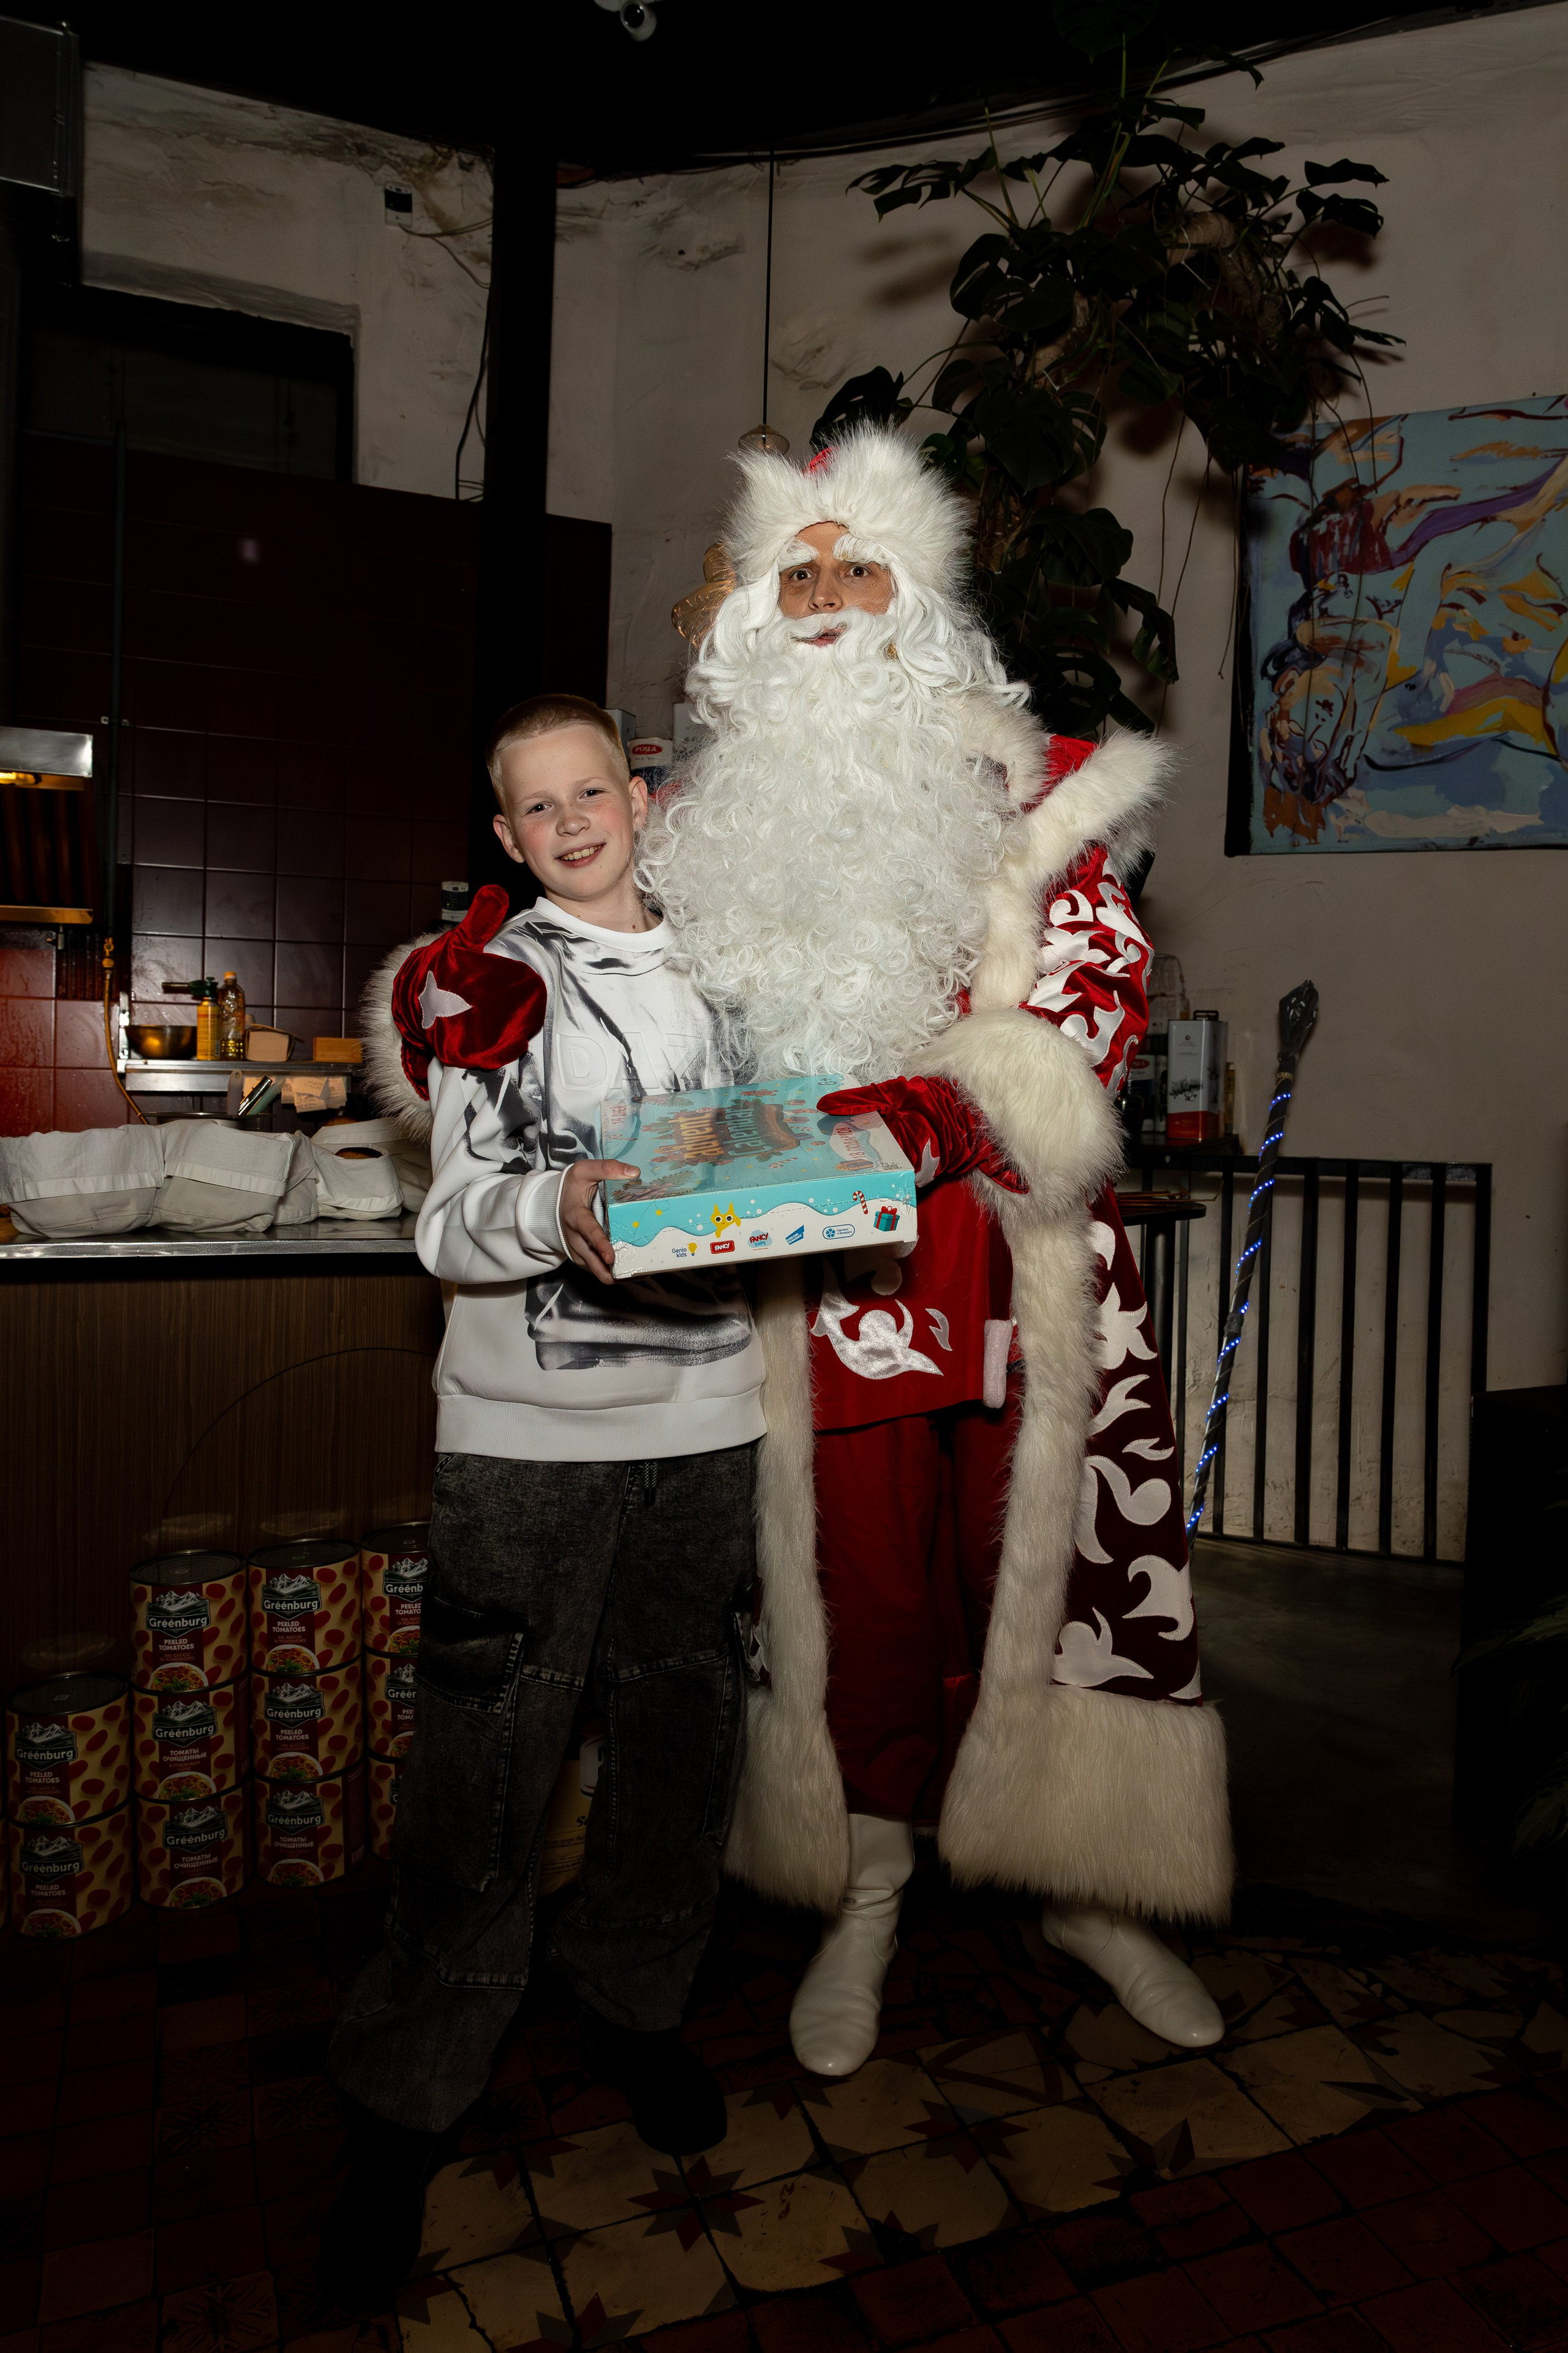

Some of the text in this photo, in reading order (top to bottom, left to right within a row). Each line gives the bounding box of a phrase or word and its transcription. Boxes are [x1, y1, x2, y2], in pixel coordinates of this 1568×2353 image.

[716, 1108, 772, 1156] Calendar
[836, 1127, 864, 1152] ПОДАРКОВ
[749, 1233, 769, 1244] FANCY
[714, 1242, 730, 1251] FANCY
[386, 1583, 423, 1593] Gréénb
[263, 1600, 318, 1610] Gréénburg
[149, 1617, 207, 1628] Gréénburg
[266, 1708, 321, 1718] Gréénburg
[155, 1726, 214, 1738] Gréénburg
[17, 1748, 74, 1760] Gréénburg
[162, 1752, 207, 1762] ОЧИЩЕННЫЕ
[268, 1814, 322, 1825] Gréénburg
[167, 1829, 225, 1845] Gréénburg
[174, 1857, 219, 1868] ОЧИЩЕННЫЕ
[181, 1853, 211, 1862] ТОМАТЫ
[21, 1862, 80, 1873] Gréénburg
